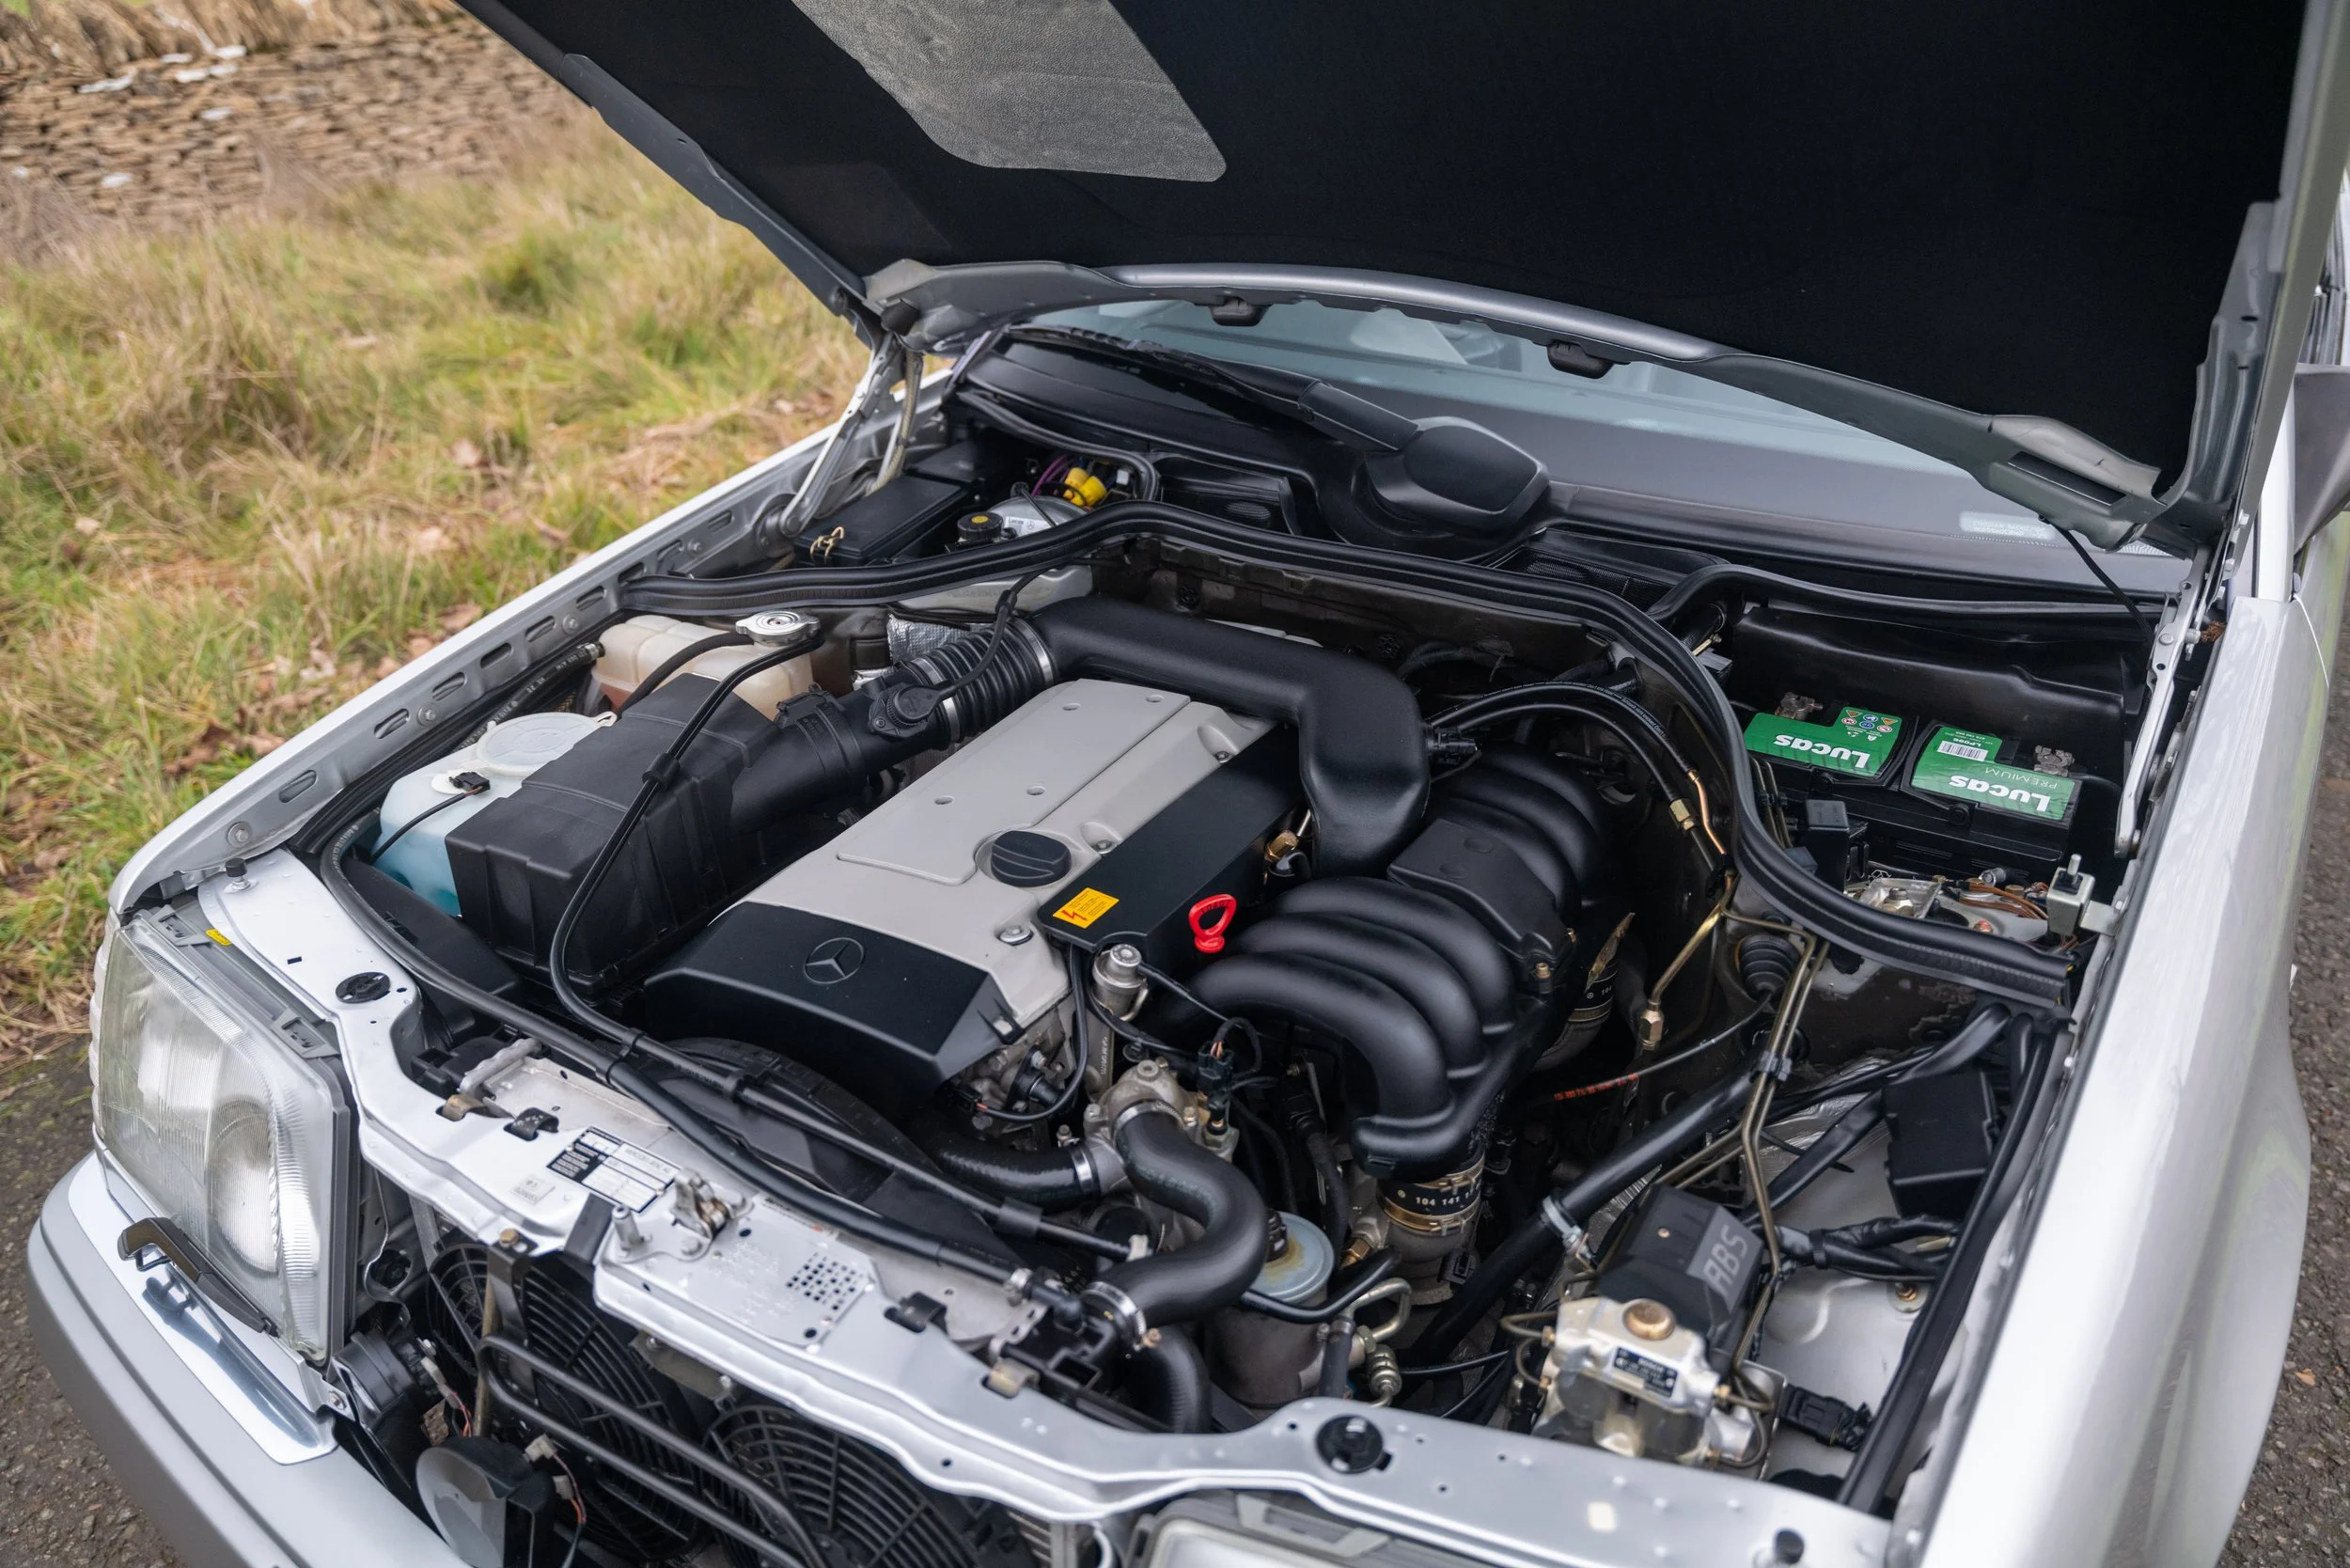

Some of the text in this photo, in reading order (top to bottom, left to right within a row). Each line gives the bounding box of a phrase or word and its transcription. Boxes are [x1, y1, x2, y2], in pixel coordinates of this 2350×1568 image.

[1774, 734, 1871, 769] Lucas
[1949, 775, 2051, 813] Lucas
[1984, 766, 2059, 791] PREMIUM
[1415, 1196, 1436, 1207] 104
[1441, 1195, 1461, 1206] 141
[1702, 1223, 1749, 1299] ABS
